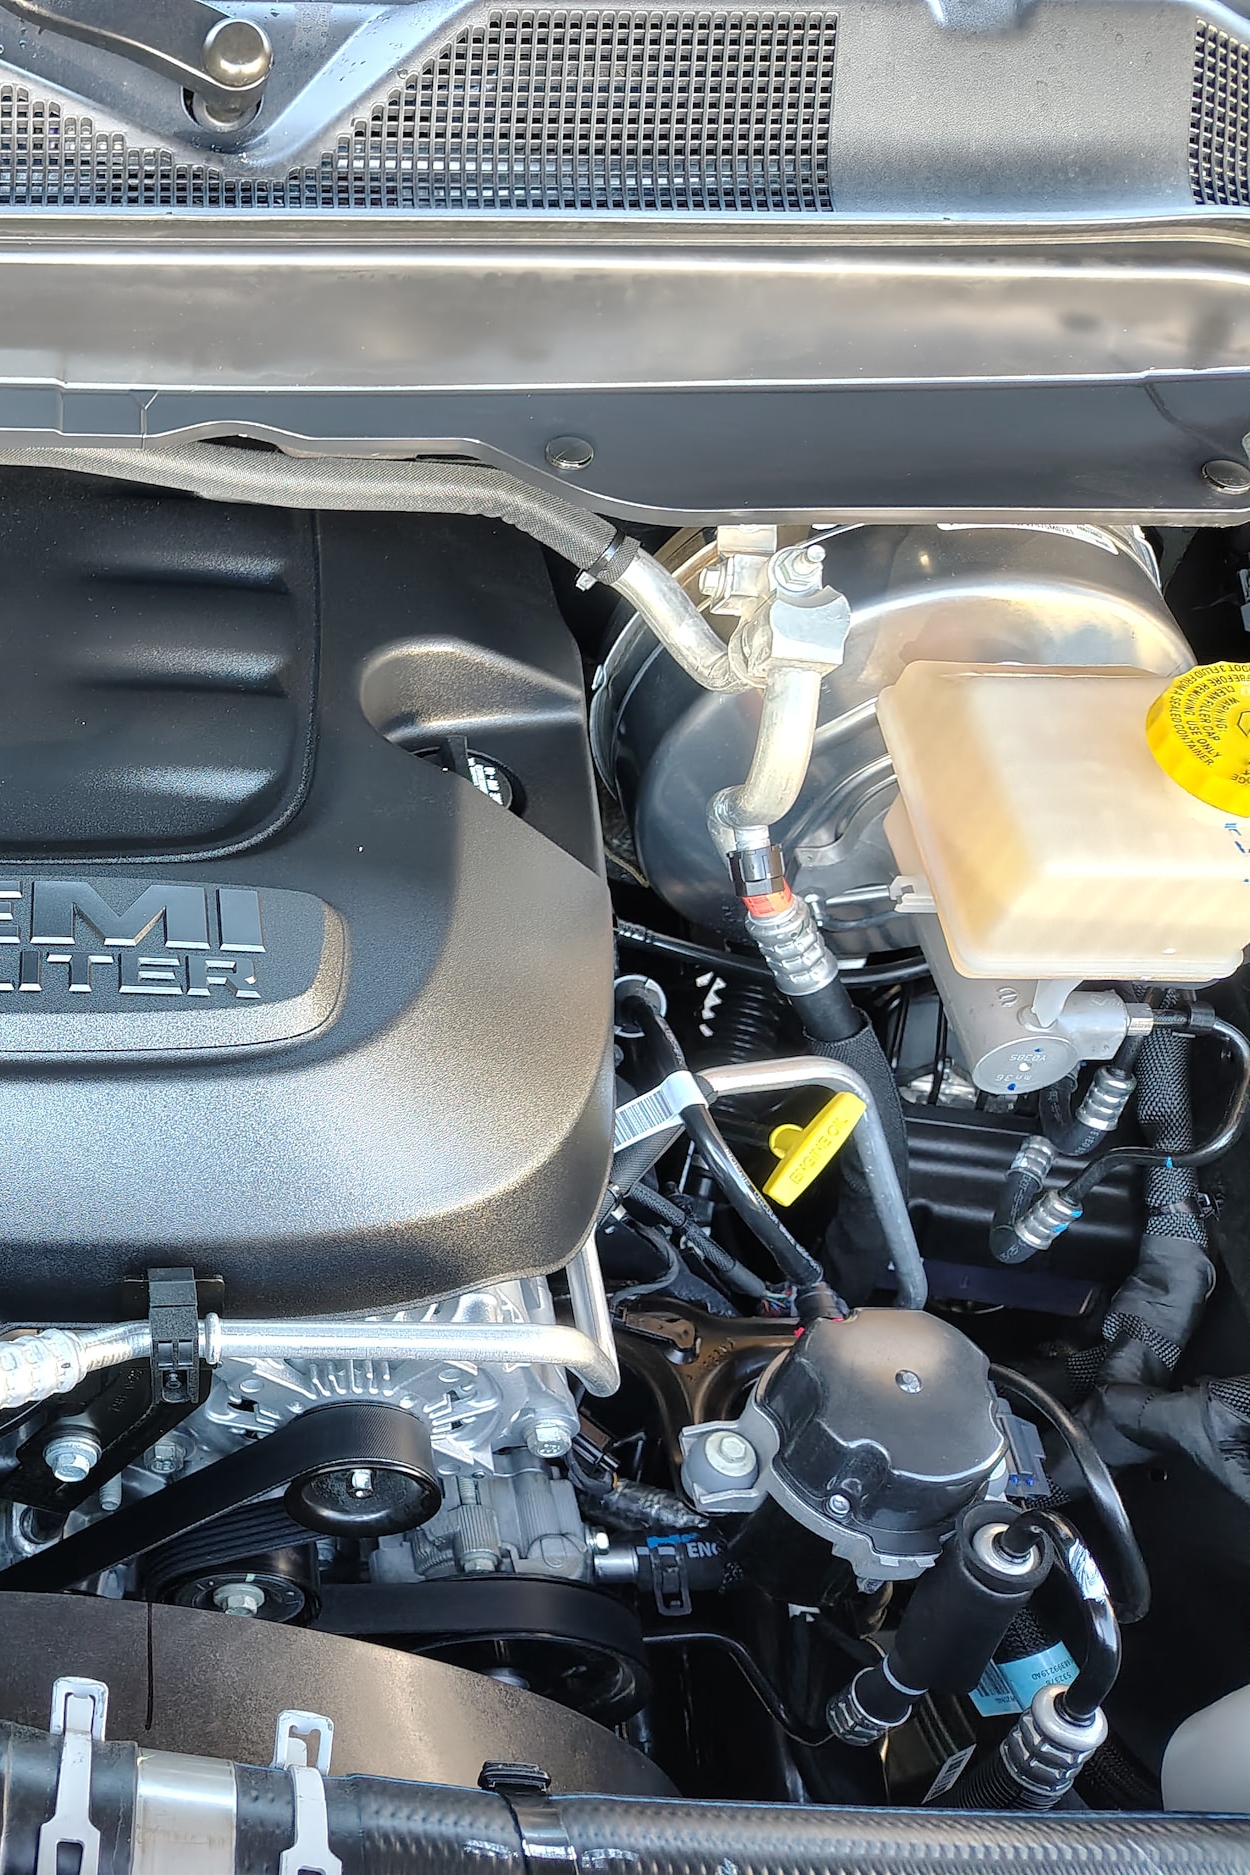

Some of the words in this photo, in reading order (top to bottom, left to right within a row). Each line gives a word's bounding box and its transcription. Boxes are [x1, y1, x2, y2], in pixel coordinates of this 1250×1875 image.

[1175, 674, 1197, 692] FROM
[1194, 666, 1220, 679] FLUID
[1207, 685, 1235, 701] CLEAN
[1169, 695, 1183, 723] SEALED
[1199, 698, 1215, 724] FILLER
[1186, 720, 1203, 736] USE
[1197, 738, 1222, 758] ONLY
[1202, 725, 1221, 741] CAP
[789, 1135, 833, 1185] ENGINE
[827, 1116, 849, 1137] OIL
